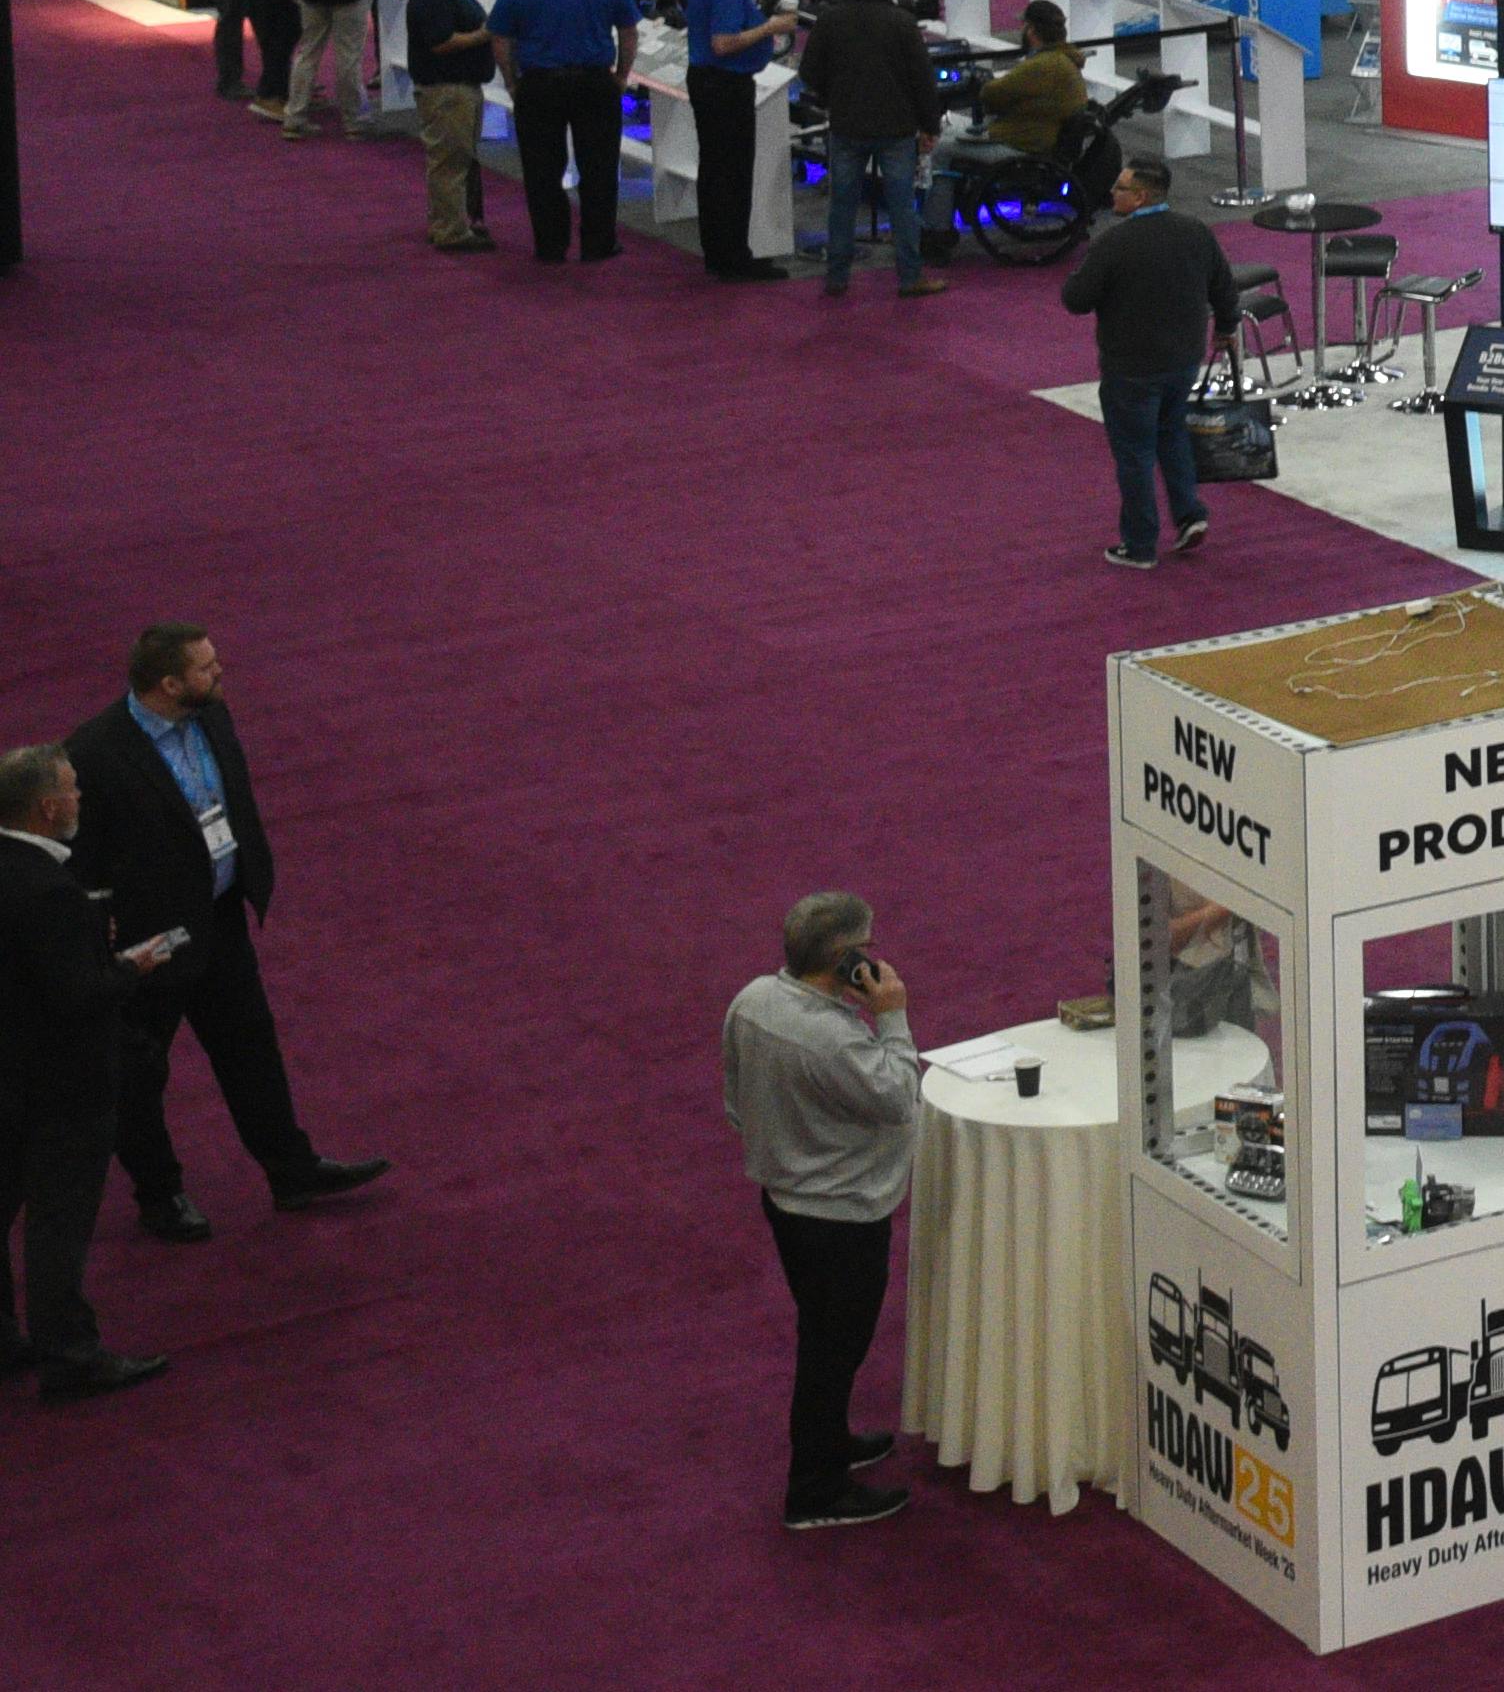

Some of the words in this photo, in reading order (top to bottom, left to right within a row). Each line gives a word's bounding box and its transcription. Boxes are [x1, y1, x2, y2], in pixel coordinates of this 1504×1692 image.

[1173, 716, 1236, 784] NEW
[1143, 762, 1271, 867] PRODUCT
[1149, 1461, 1174, 1492] Heavy
[1176, 1476, 1198, 1506] Duty
[1200, 1493, 1250, 1551] Aftermarket
[1252, 1537, 1278, 1571] Week
[1281, 1557, 1296, 1582] '25
[1367, 1550, 1422, 1587] Heavy
[1427, 1538, 1470, 1572] Duty
